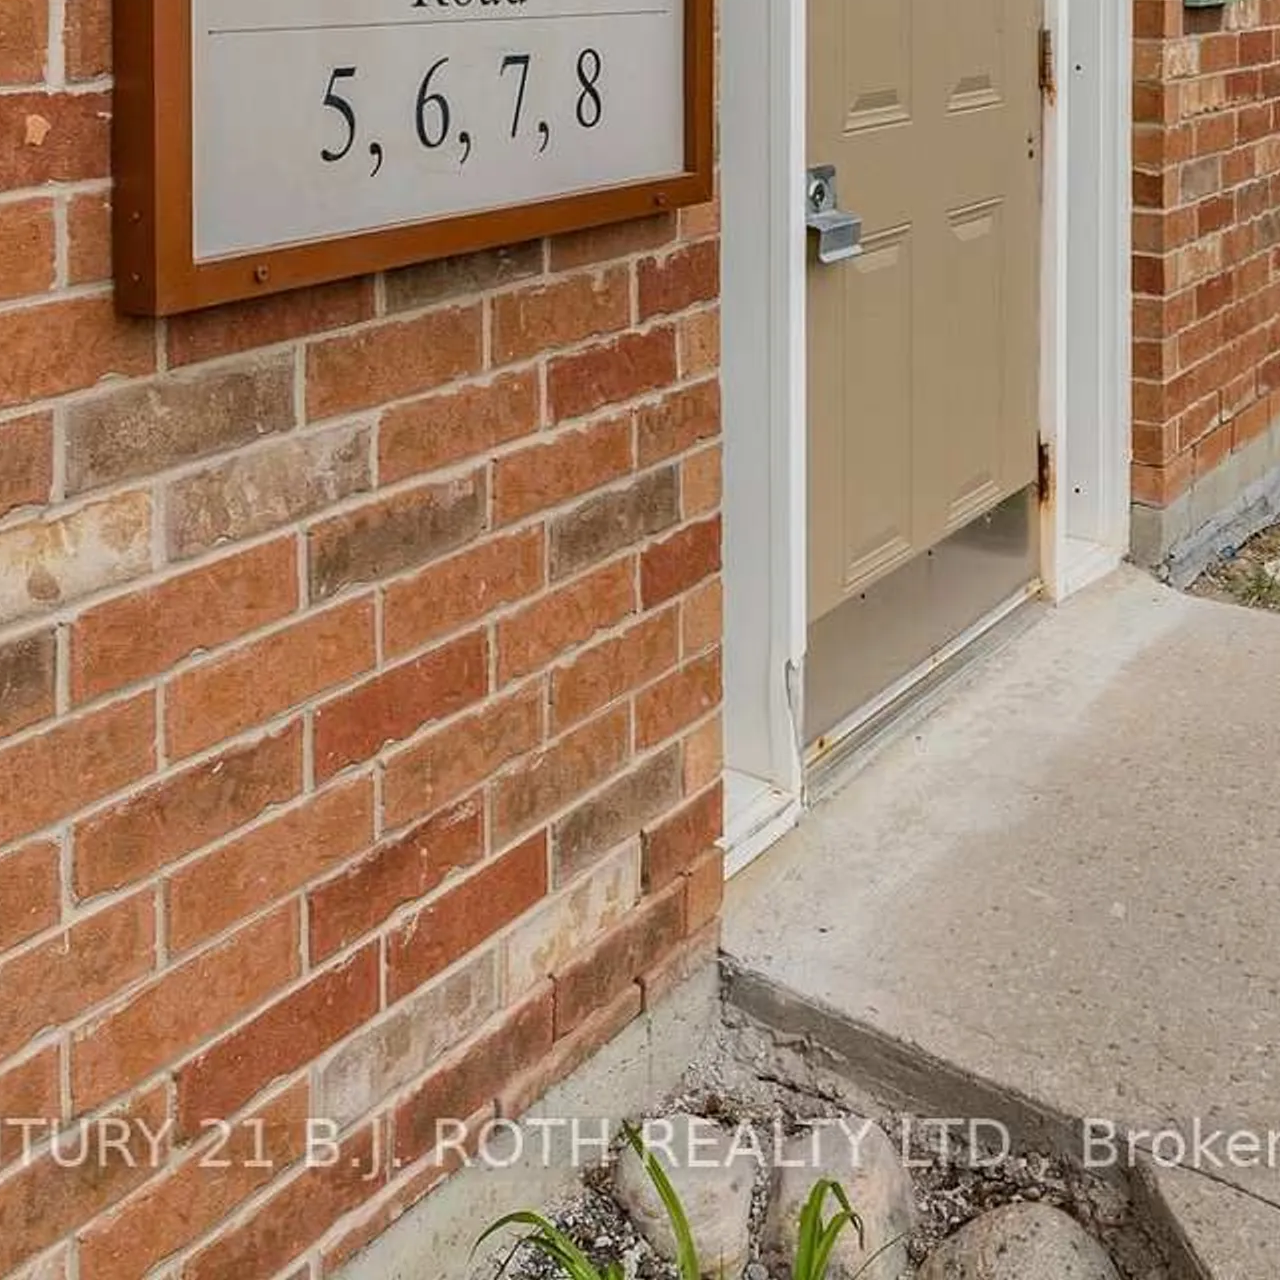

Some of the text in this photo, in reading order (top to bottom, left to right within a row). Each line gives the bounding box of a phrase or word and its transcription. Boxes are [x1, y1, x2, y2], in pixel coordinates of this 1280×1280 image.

[320, 48, 603, 177] 5, 6, 7, 8
